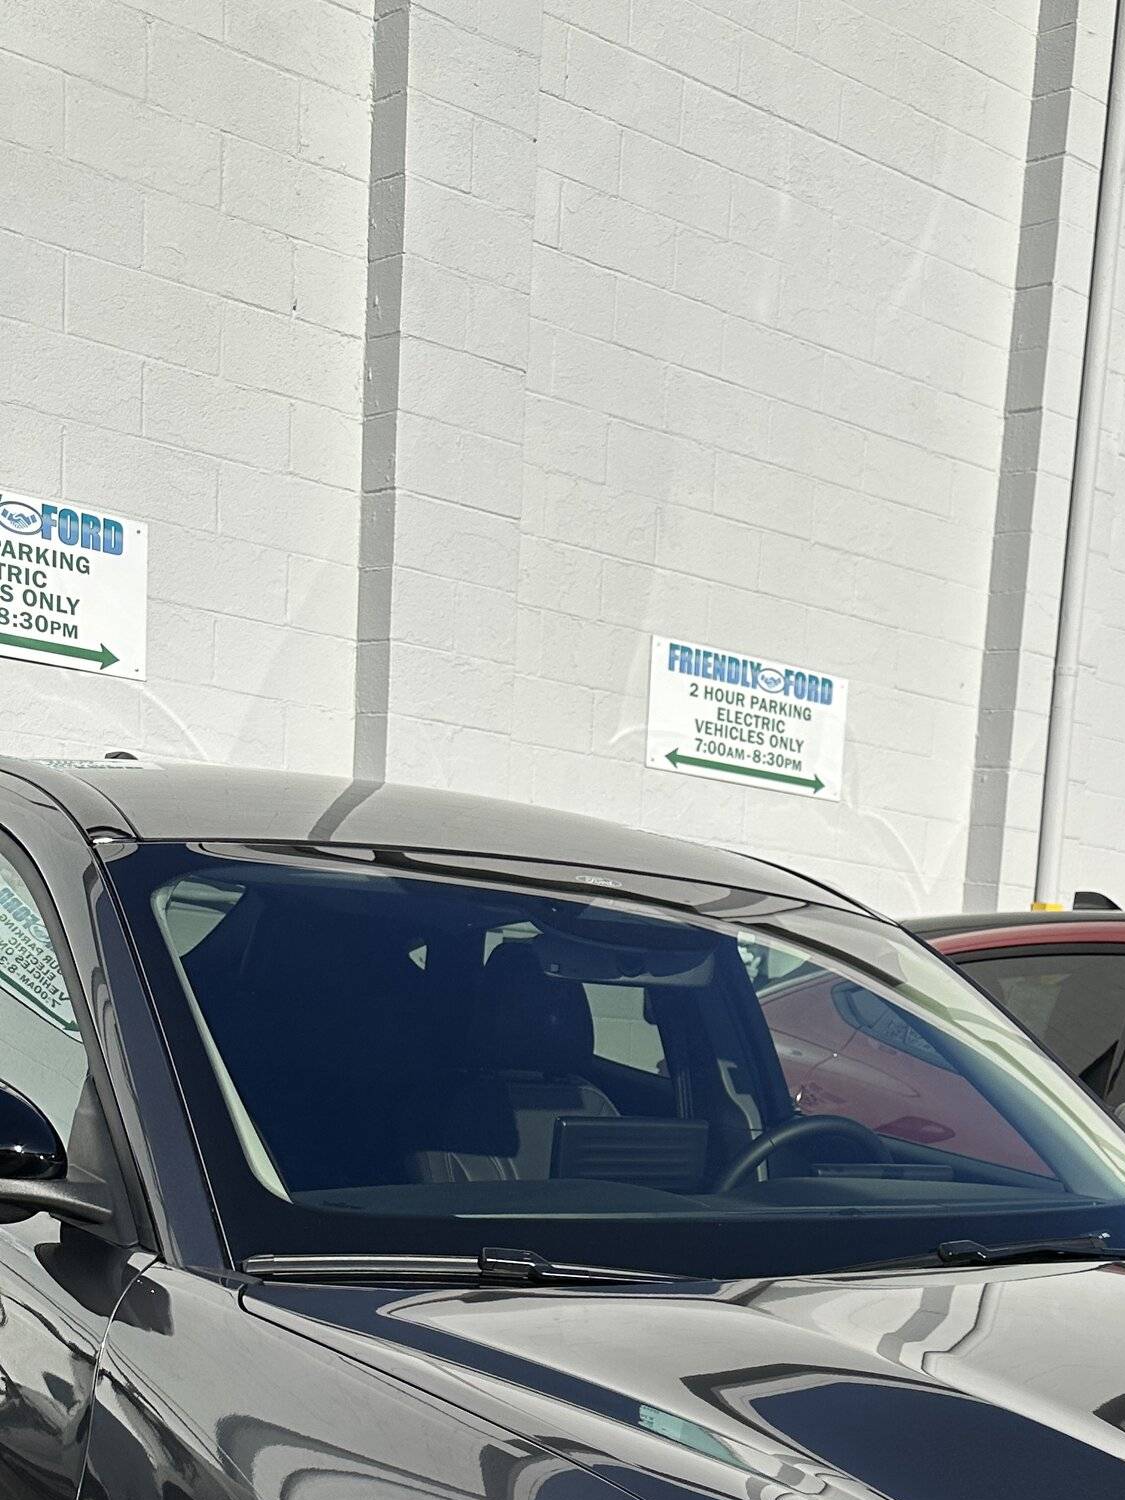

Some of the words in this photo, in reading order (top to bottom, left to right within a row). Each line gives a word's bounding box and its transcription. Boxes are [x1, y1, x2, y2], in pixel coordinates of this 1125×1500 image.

[41, 503, 124, 556] FORD
[0, 539, 91, 575] ARKING
[22, 589, 80, 616] ONLY
[668, 642, 761, 690] FRIENDLY
[783, 668, 834, 706] FORD
[689, 683, 699, 698] 2
[704, 686, 745, 708] HOUR
[750, 696, 812, 722] PARKING
[717, 707, 786, 734] ELECTRIC
[694, 718, 764, 746] VEHICLES
[769, 734, 805, 754] ONLY
